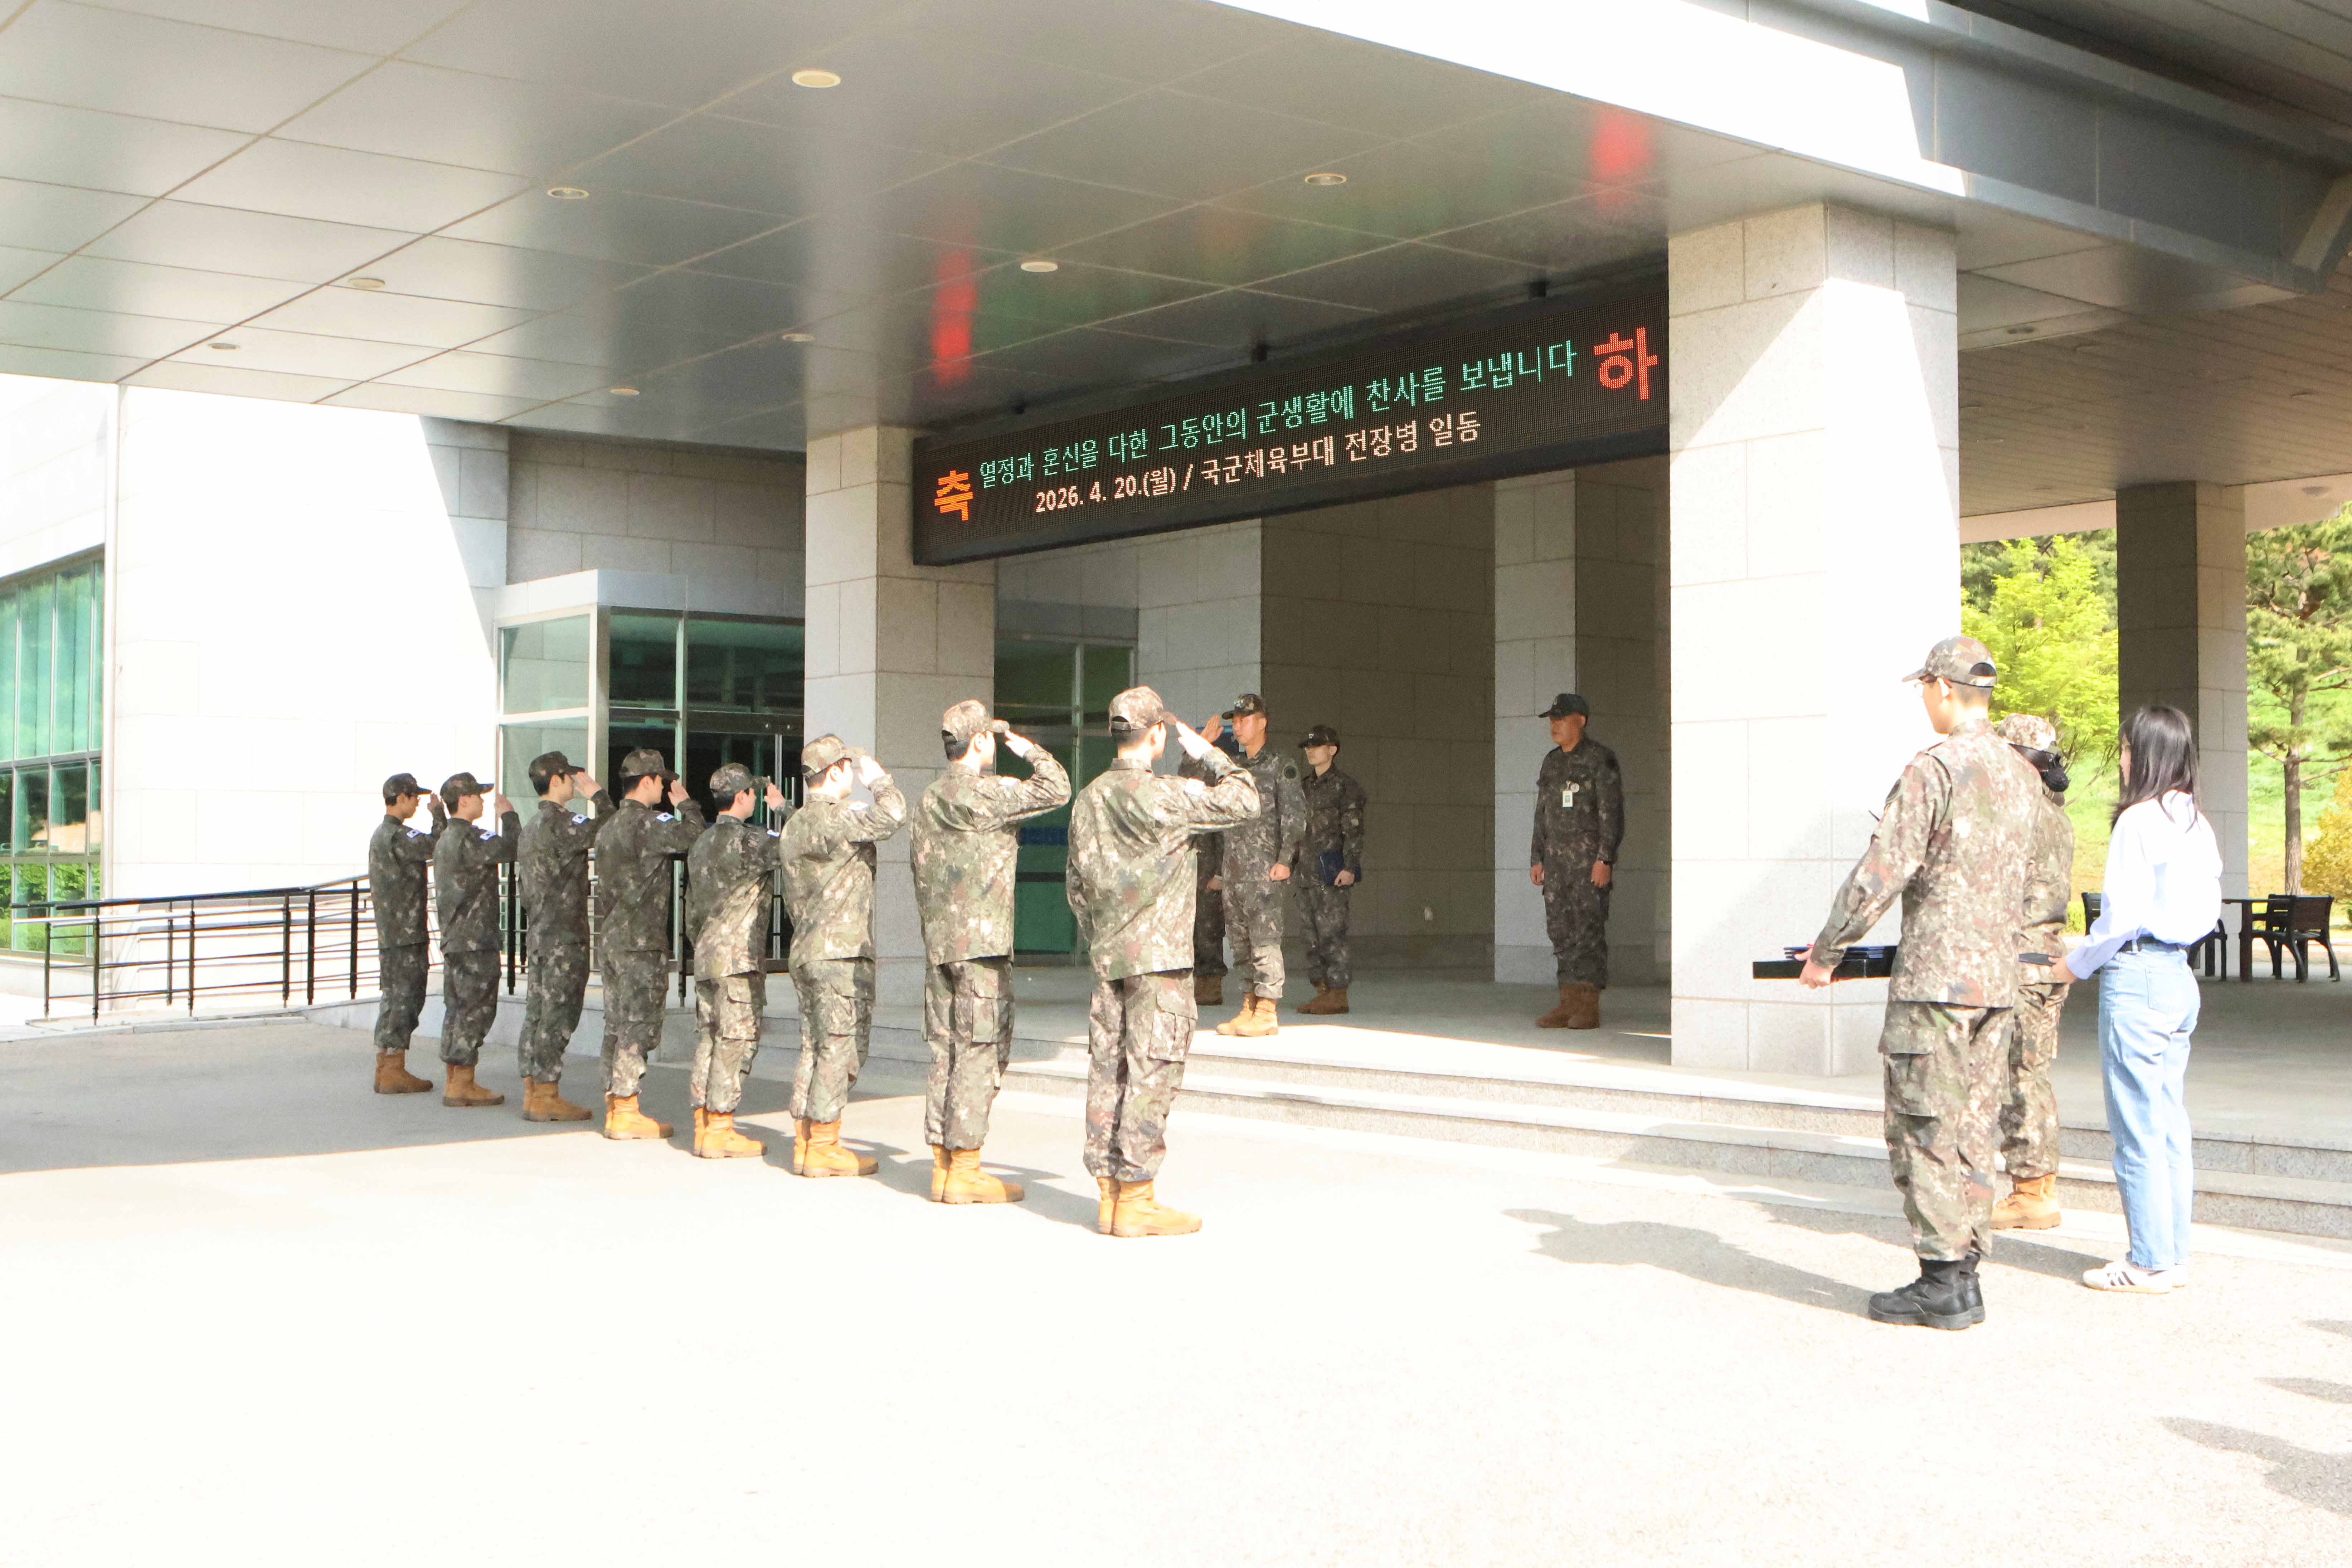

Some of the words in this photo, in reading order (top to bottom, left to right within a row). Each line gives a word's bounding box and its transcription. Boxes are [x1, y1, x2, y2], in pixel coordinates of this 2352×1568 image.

[1594, 327, 1657, 400] 하
[980, 453, 1034, 488] 열정과
[1043, 440, 1098, 475] 혼신을
[1109, 429, 1148, 462] 다한
[1159, 408, 1245, 449] 그동안의
[1257, 386, 1353, 433] 군생활에
[1366, 367, 1445, 412] 찬사를
[1461, 340, 1576, 390] 보냅니다
[934, 470, 973, 521] 축
[1036, 486, 1083, 512] 2026.
[1089, 482, 1106, 502] 4.
[1114, 467, 1176, 498] 20.(월)
[1182, 464, 1193, 490] /
[1201, 436, 1334, 485] 국군체육부대
[1345, 420, 1417, 461] 전장병
[1429, 412, 1480, 446] 일동
